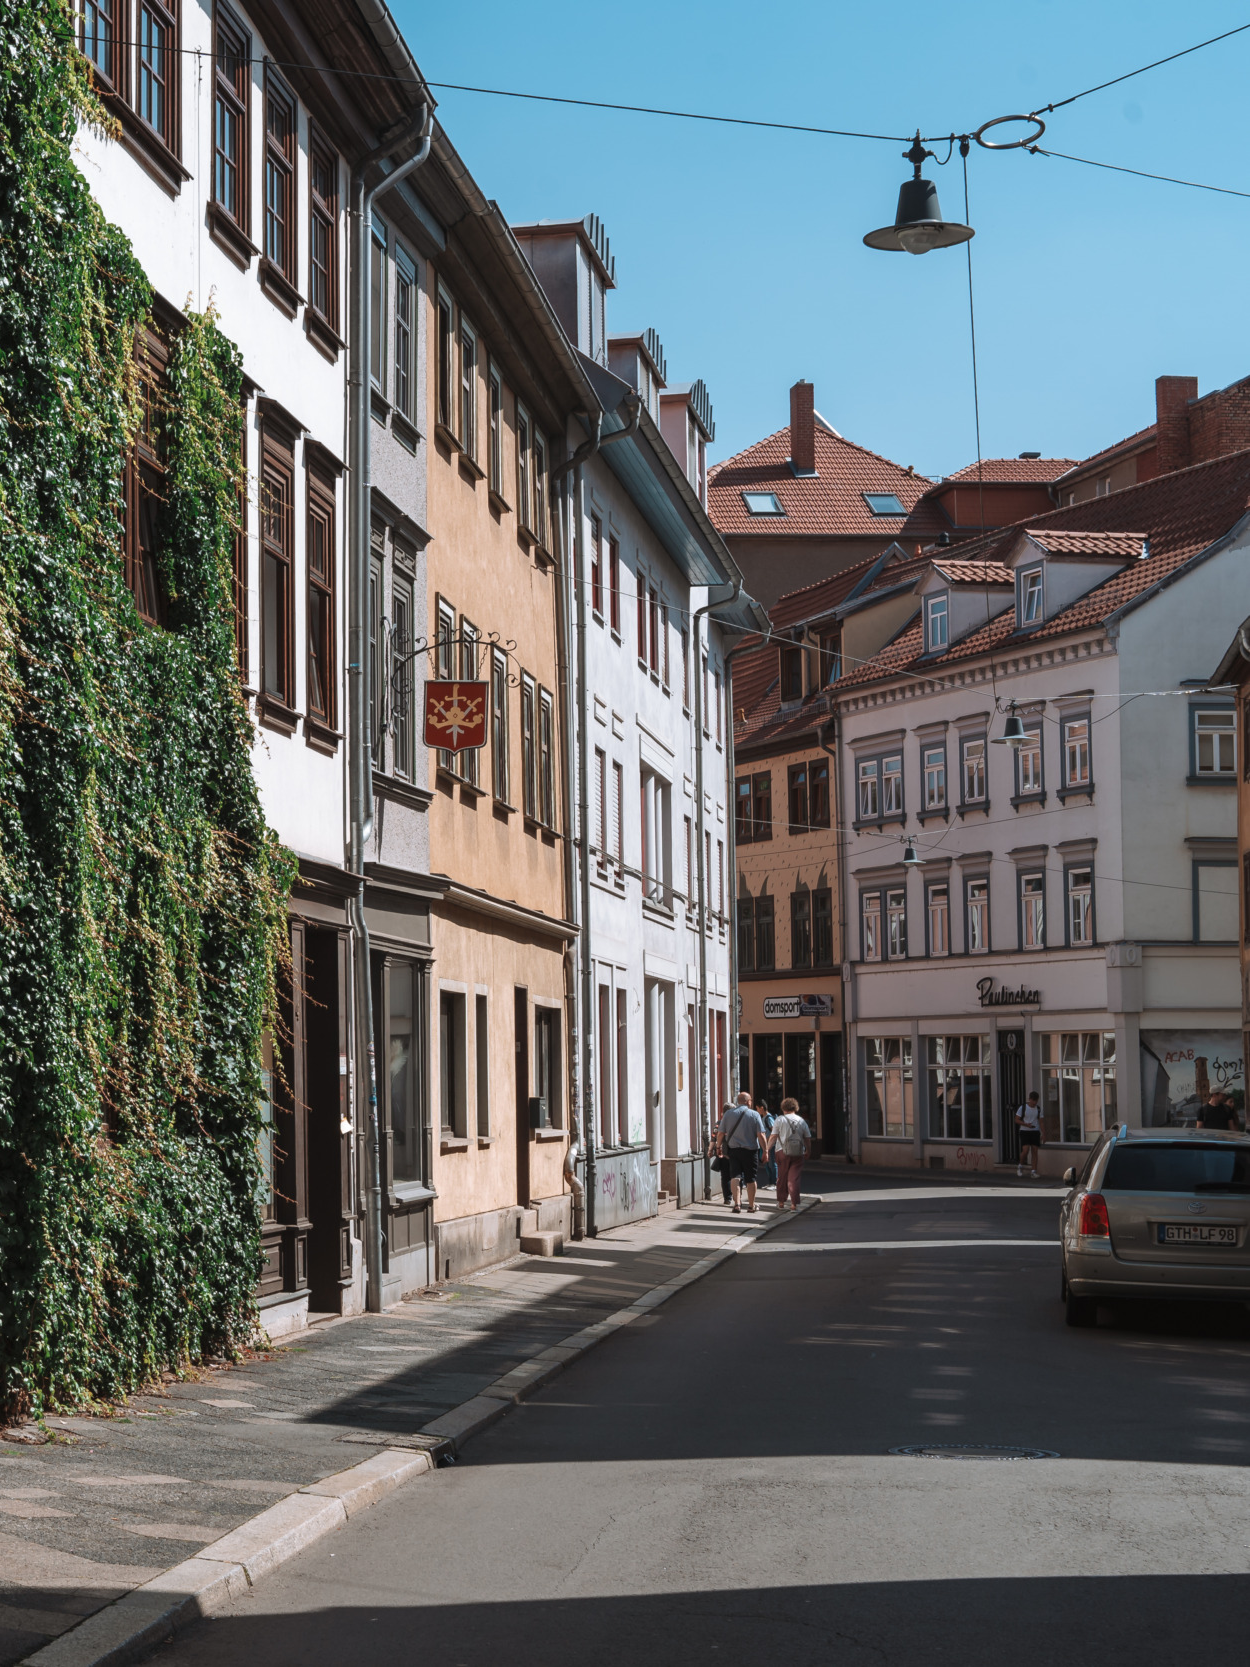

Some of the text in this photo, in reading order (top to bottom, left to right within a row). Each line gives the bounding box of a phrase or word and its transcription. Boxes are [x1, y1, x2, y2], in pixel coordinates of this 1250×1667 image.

[976, 976, 1040, 1008] Paulinchen
[764, 999, 800, 1017] domsport
[1164, 1048, 1195, 1064] ACAB
[1166, 1226, 1235, 1241] GTH LF 98
